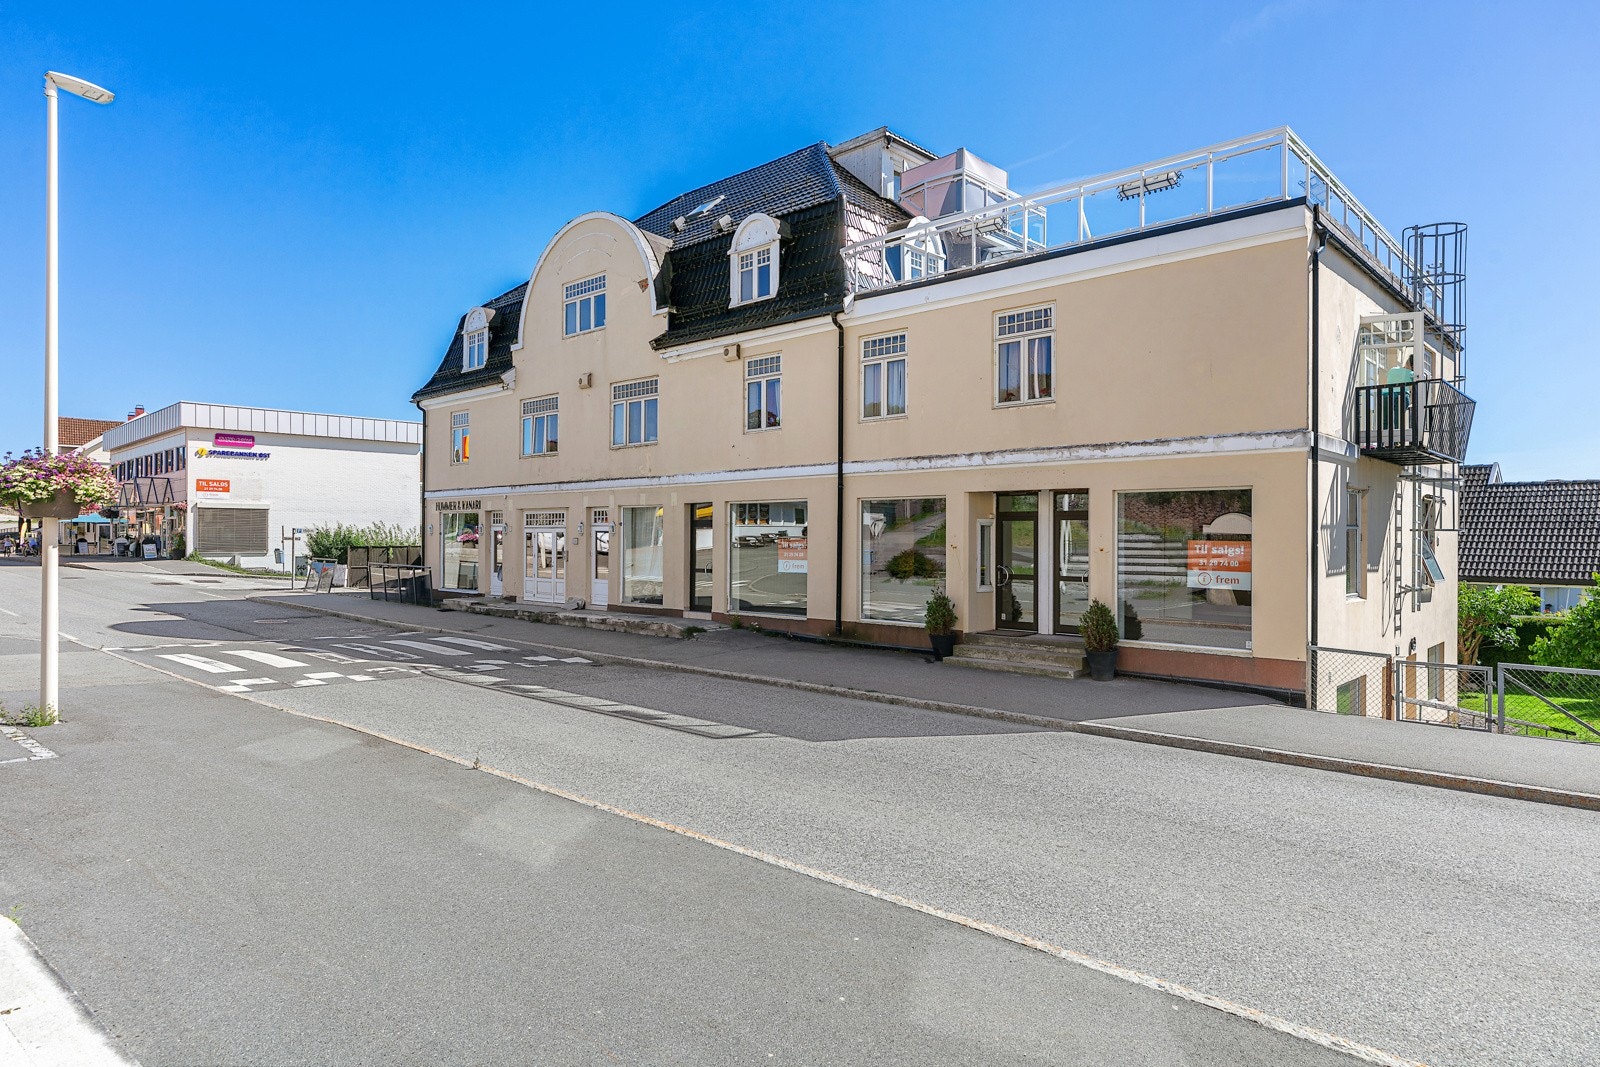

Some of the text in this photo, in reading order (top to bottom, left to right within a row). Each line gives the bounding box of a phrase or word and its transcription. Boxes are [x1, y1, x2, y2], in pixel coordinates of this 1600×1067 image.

[1195, 544, 1244, 556] Til salgs!
[1216, 575, 1240, 584] frem
